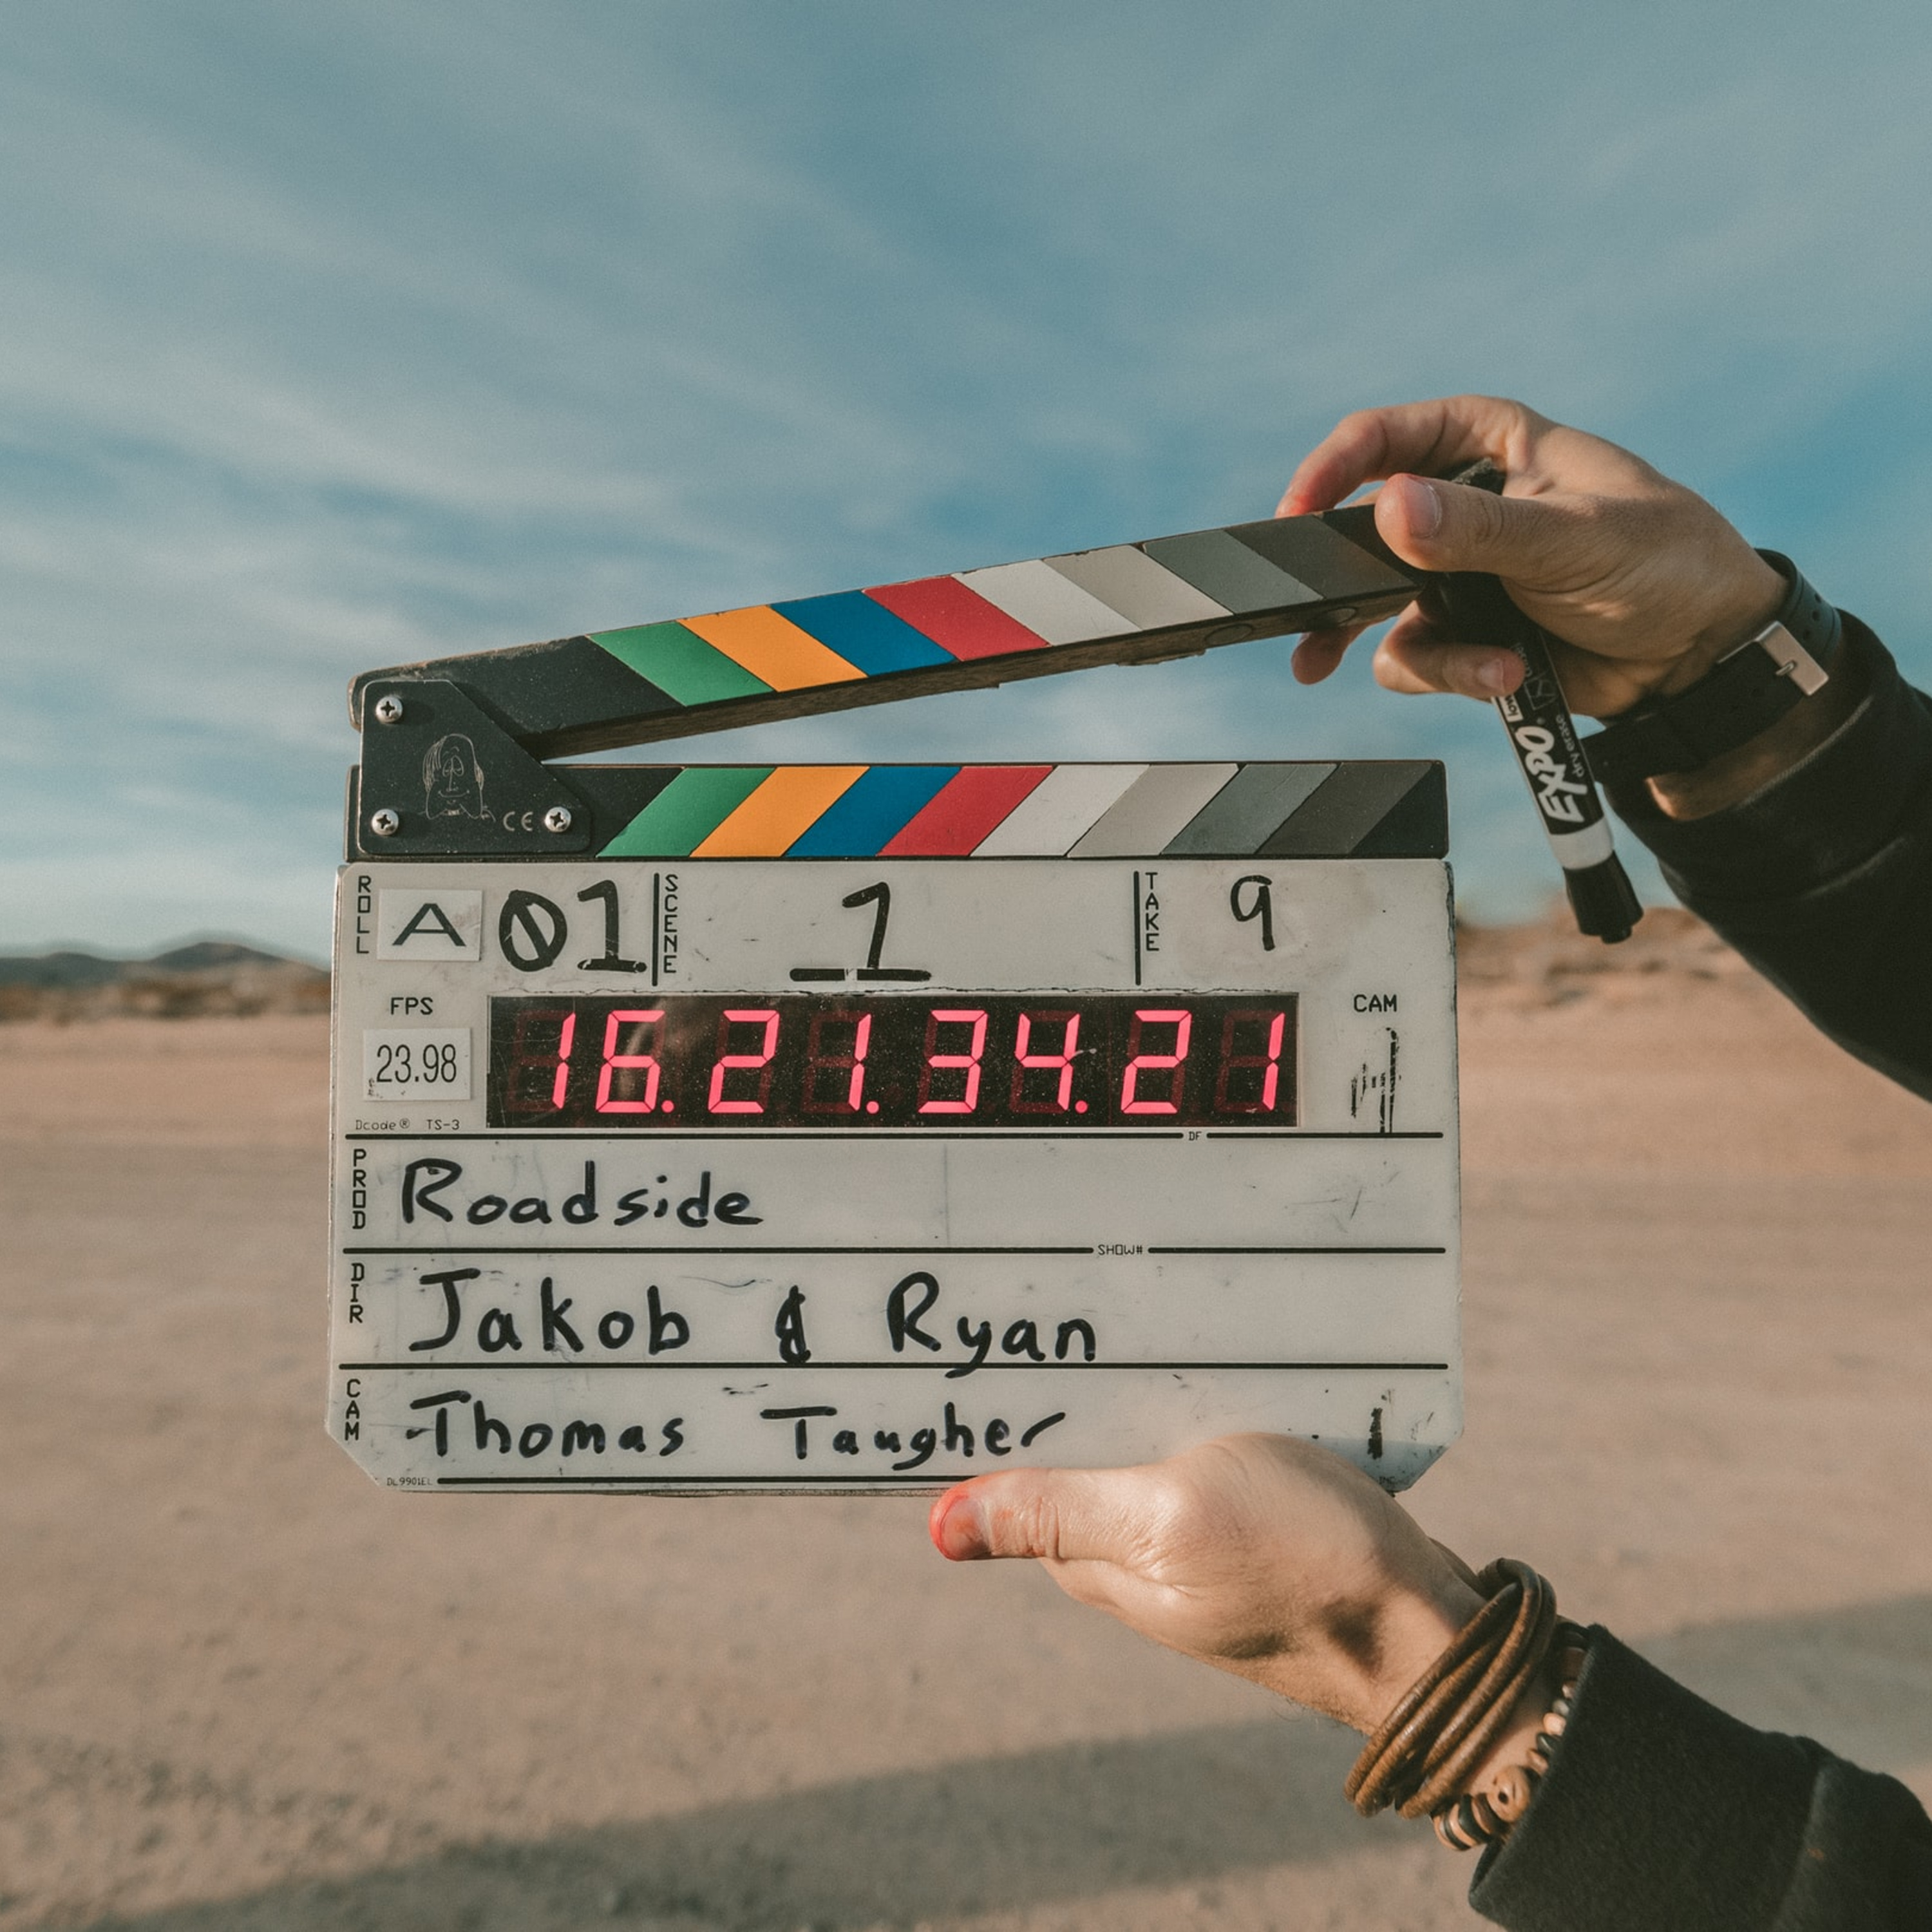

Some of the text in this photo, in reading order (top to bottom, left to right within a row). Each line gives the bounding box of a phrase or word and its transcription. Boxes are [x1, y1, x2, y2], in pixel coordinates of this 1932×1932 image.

[1515, 726, 1588, 822] EXPO
[1556, 714, 1585, 777] dry erase
[356, 875, 372, 954] ROLL
[392, 903, 466, 947] A
[499, 880, 648, 973] 01
[663, 874, 679, 974] SCENE
[1145, 871, 1160, 952] TAKE
[1229, 875, 1276, 952] 9
[390, 996, 433, 1016] FPS
[1353, 994, 1397, 1013] CAM
[376, 1043, 457, 1083] 23.98
[426, 1119, 460, 1131] TS-3
[1188, 1131, 1202, 1141] DF
[352, 1148, 367, 1230] PROD
[402, 1157, 764, 1227] Roadside
[1097, 1244, 1143, 1256] SHOW#
[350, 1262, 365, 1323] DIR
[409, 1267, 690, 1355] Jakob
[887, 1271, 1096, 1379] Ryan
[345, 1378, 361, 1441] CAM
[406, 1390, 1066, 1471] Thomas Taugher
